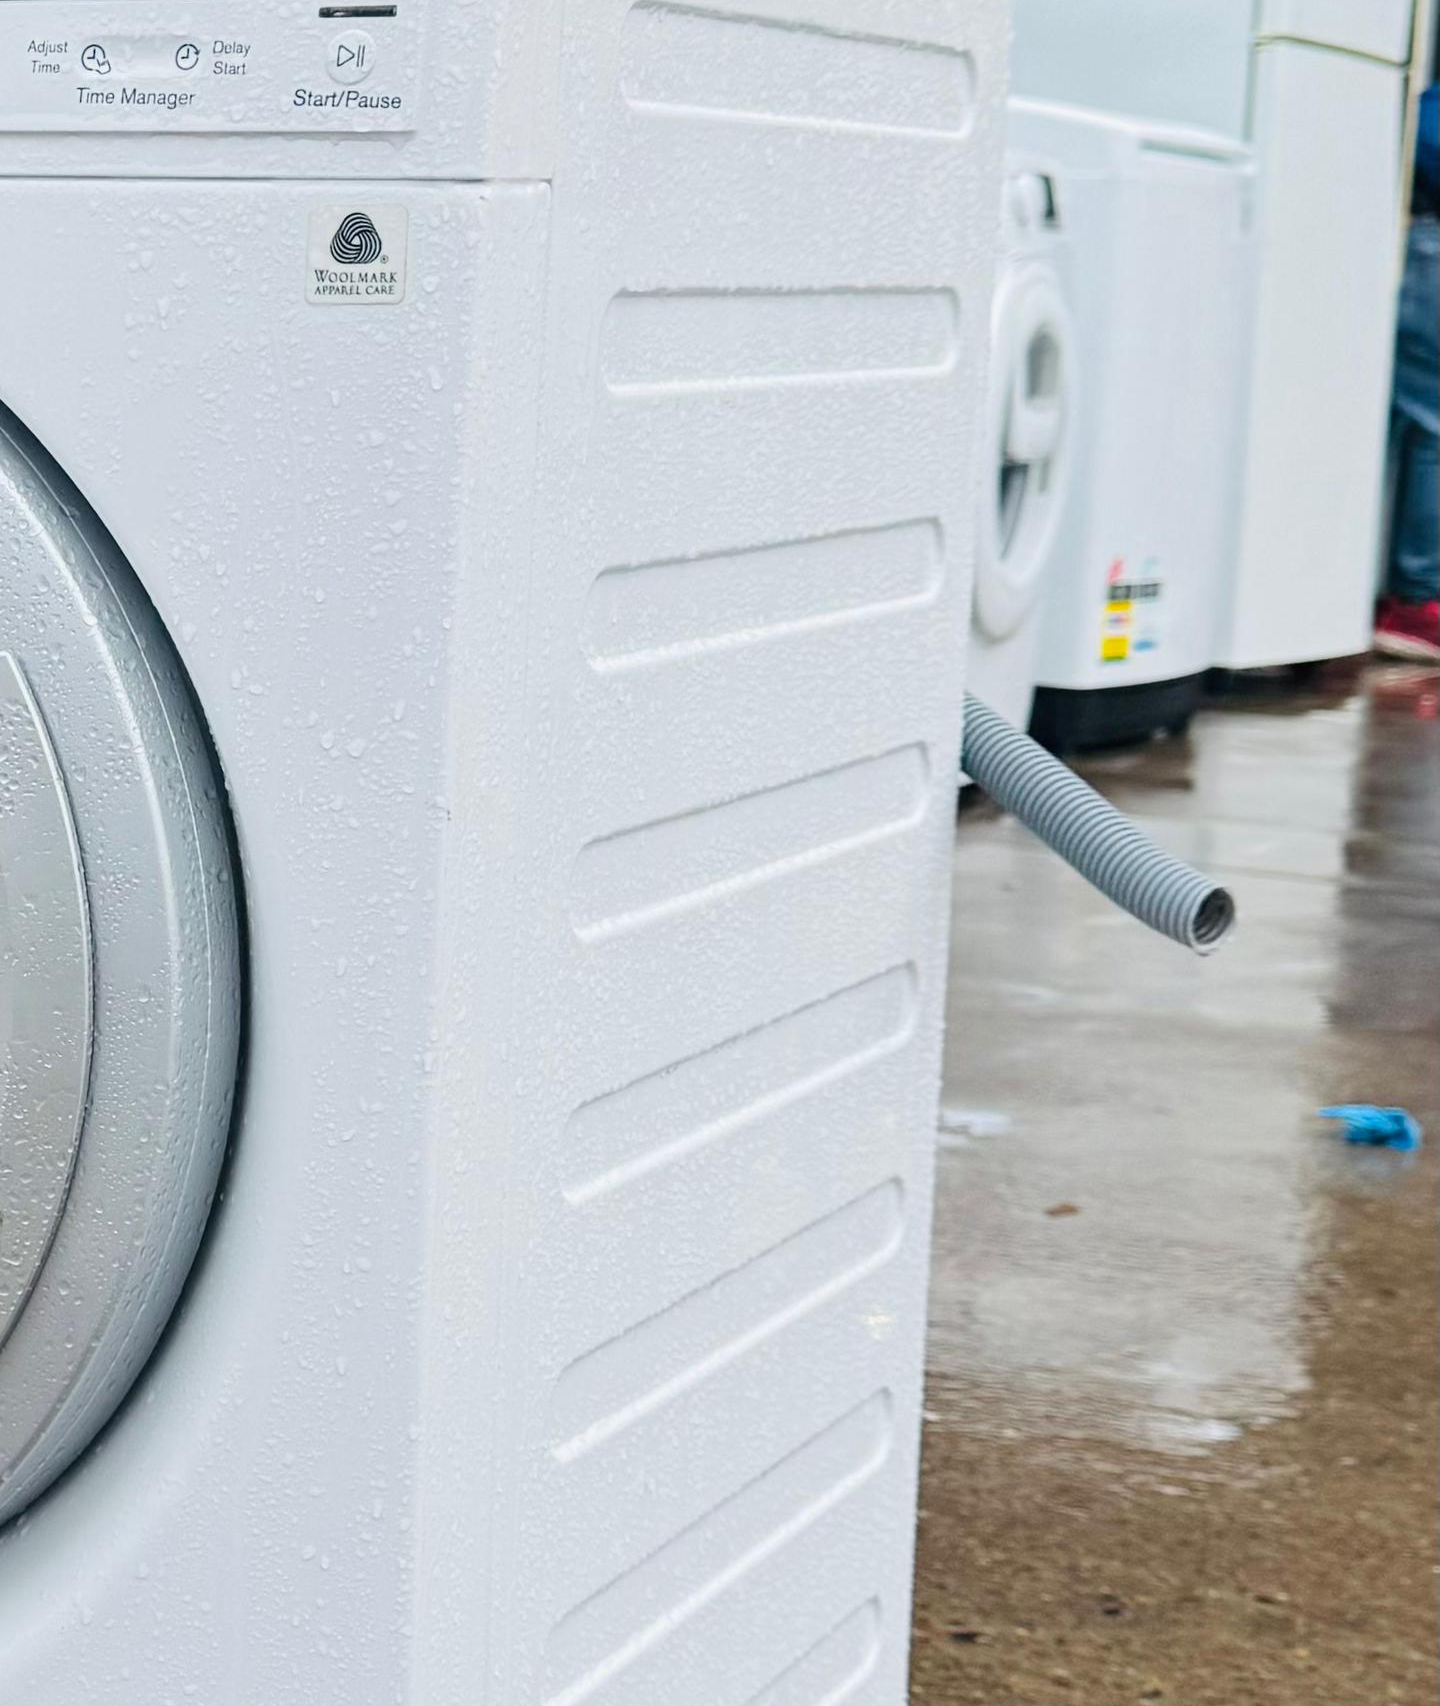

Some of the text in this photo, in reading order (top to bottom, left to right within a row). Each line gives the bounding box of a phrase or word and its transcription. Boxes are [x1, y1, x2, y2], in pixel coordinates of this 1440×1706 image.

[27, 40, 68, 56] Adjust
[213, 41, 250, 56] Delay
[31, 60, 60, 74] Time
[213, 60, 246, 75] Start
[77, 87, 196, 109] Time Manager
[293, 89, 402, 109] Start/Pause
[314, 269, 398, 283] WOOLMARK
[314, 285, 395, 295] APPAREL CARE
